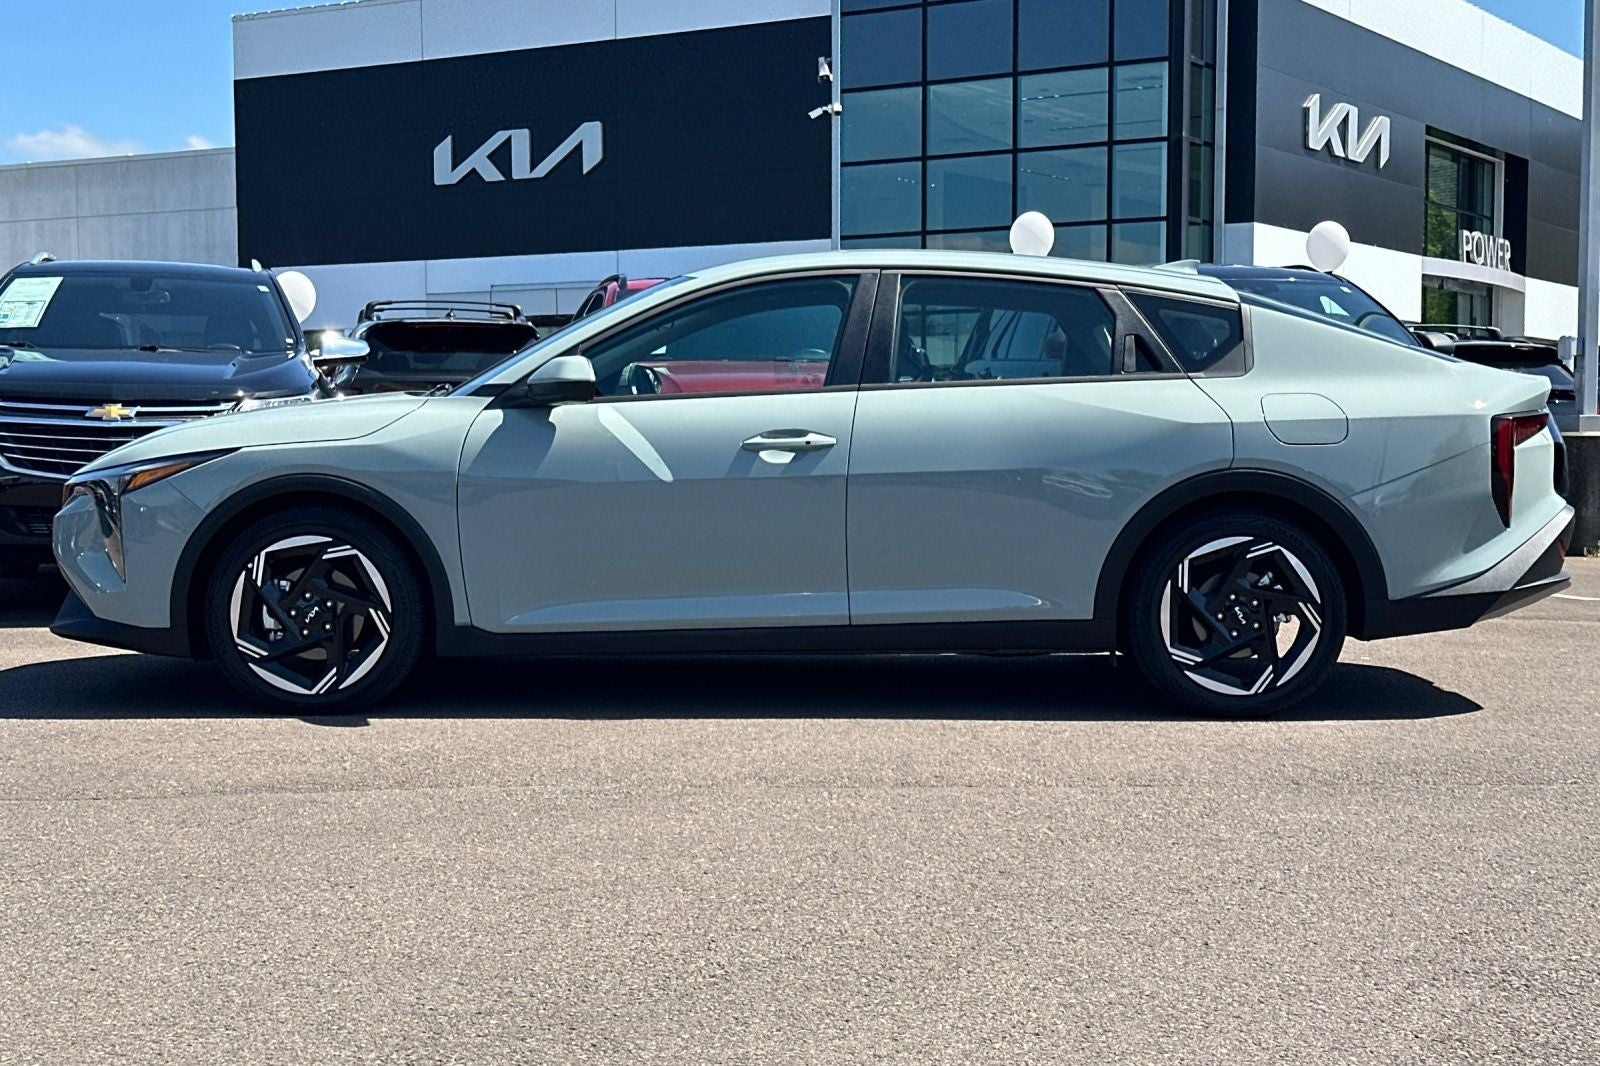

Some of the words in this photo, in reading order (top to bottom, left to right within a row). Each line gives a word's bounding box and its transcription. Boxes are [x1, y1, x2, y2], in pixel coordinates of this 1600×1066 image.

[433, 120, 604, 186] KIA
[1303, 93, 1391, 169] KIA
[1459, 229, 1511, 272] POWER
